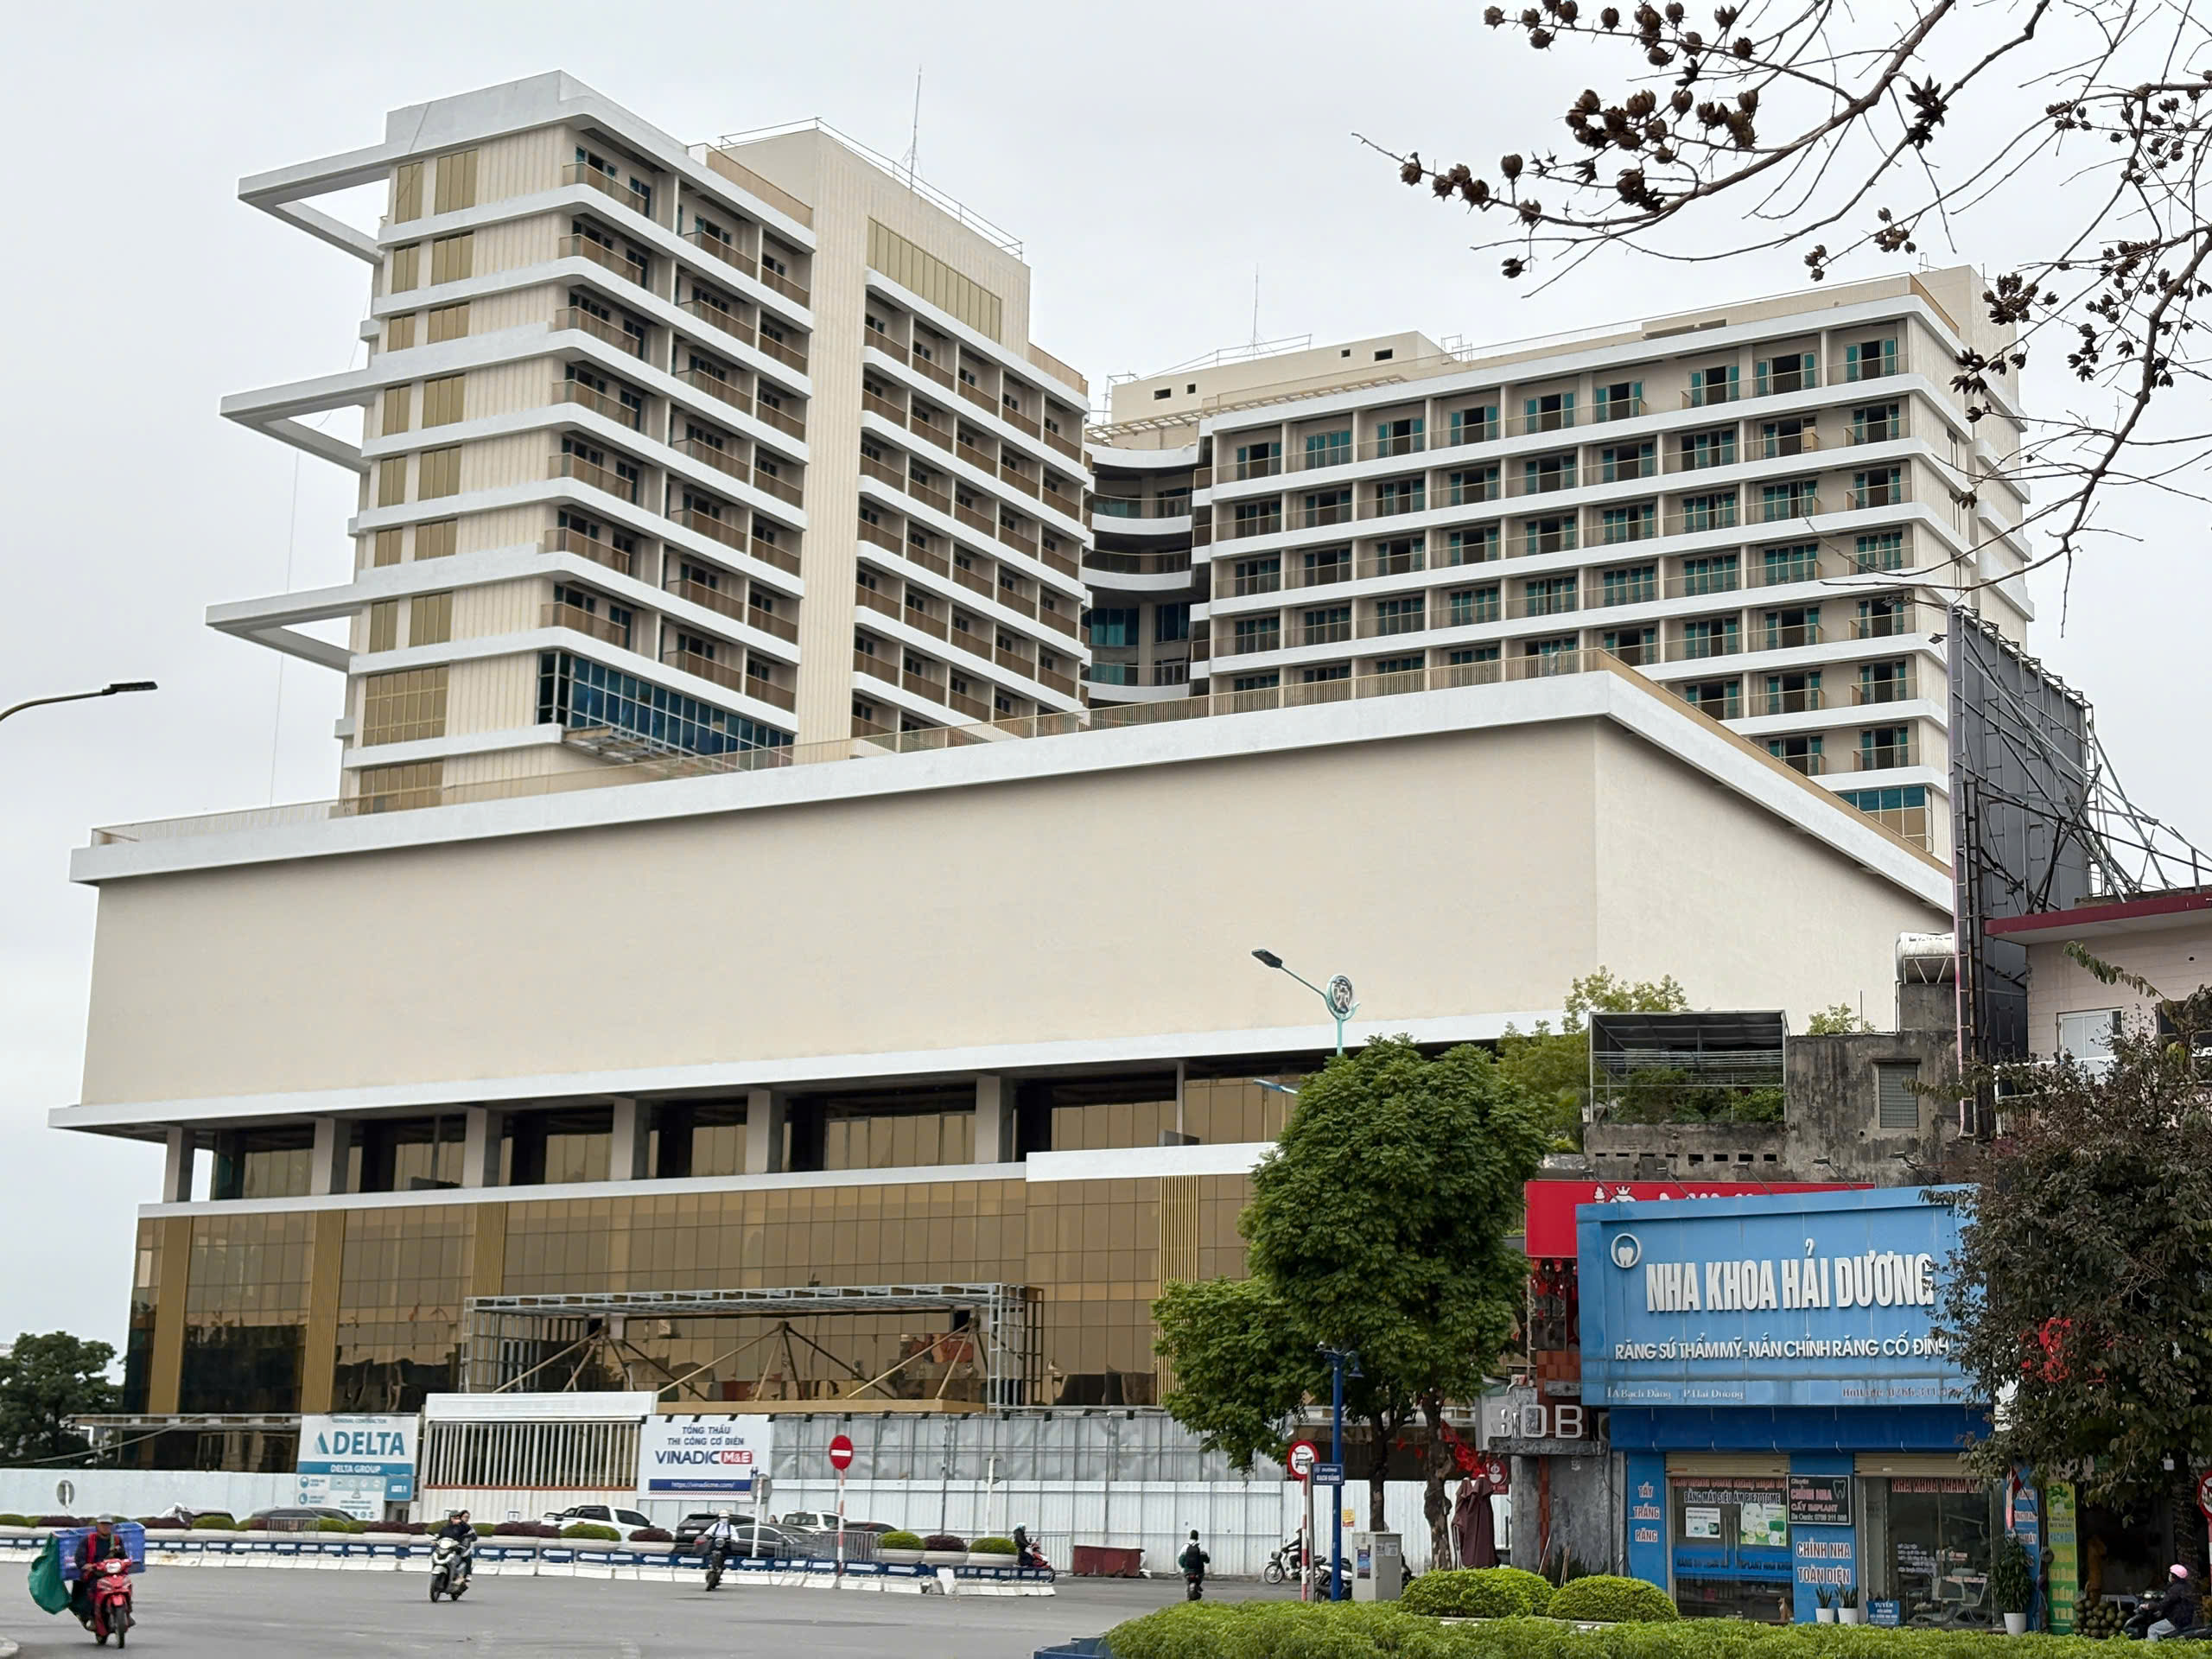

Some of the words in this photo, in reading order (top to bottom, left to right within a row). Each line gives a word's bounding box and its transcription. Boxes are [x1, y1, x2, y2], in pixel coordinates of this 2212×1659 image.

[1646, 1262, 1701, 1312] NHA
[1706, 1259, 1778, 1311] KHOA
[1781, 1237, 1830, 1308] HẢI
[1834, 1249, 1935, 1307] DƯƠNG
[1615, 1339, 1656, 1360] RĂNG
[1659, 1336, 1676, 1359] SỨ
[1783, 1333, 1830, 1357] CHỈNH
[1833, 1334, 1879, 1357] RĂNG
[1883, 1329, 1910, 1357] CỐ
[333, 1431, 405, 1456] DELTA
[667, 1437, 681, 1446] THI
[683, 1436, 708, 1446] CÔNG
[655, 1450, 721, 1465] VINADIC
[722, 1452, 751, 1464] M&E
[330, 1464, 353, 1473] DELTA
[354, 1465, 382, 1474] GROUP
[1702, 1489, 1717, 1503] MÁY
[1732, 1489, 1745, 1503] ÂM
[1633, 1502, 1660, 1519] TRẮNG
[1635, 1528, 1658, 1542] RĂNG
[1796, 1536, 1827, 1559] CHỈNH
[1829, 1541, 1852, 1559] NHA
[1797, 1564, 1826, 1584] TOÀN
